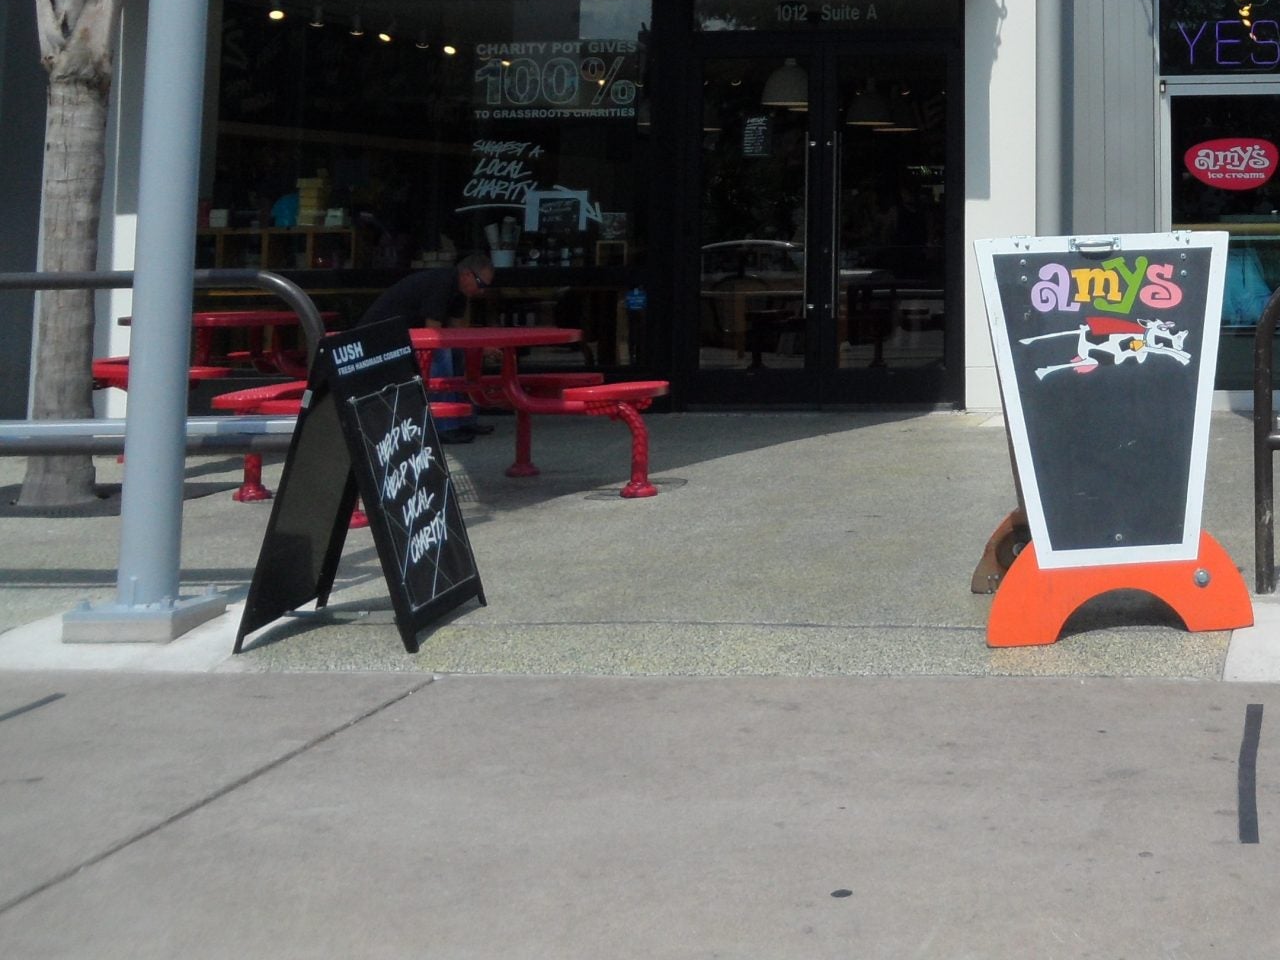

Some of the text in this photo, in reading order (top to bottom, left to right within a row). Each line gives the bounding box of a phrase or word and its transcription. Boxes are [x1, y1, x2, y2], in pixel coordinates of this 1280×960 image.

[776, 3, 878, 21] 1012 Suite A
[476, 41, 637, 55] CHARITY POT GIVES
[475, 56, 636, 105] 100%
[475, 108, 635, 119] TO GRASSROOTS CHARITIES
[528, 145, 545, 158] A
[473, 158, 533, 178] LOCAL
[463, 179, 539, 203] CHARITY
[332, 341, 365, 365] LUSH
[338, 345, 412, 376] FRESH HANDMADE COSMETICS
[376, 427, 400, 467] HELP
[402, 486, 435, 526] LOCAL
[410, 510, 448, 563] CHARITY
